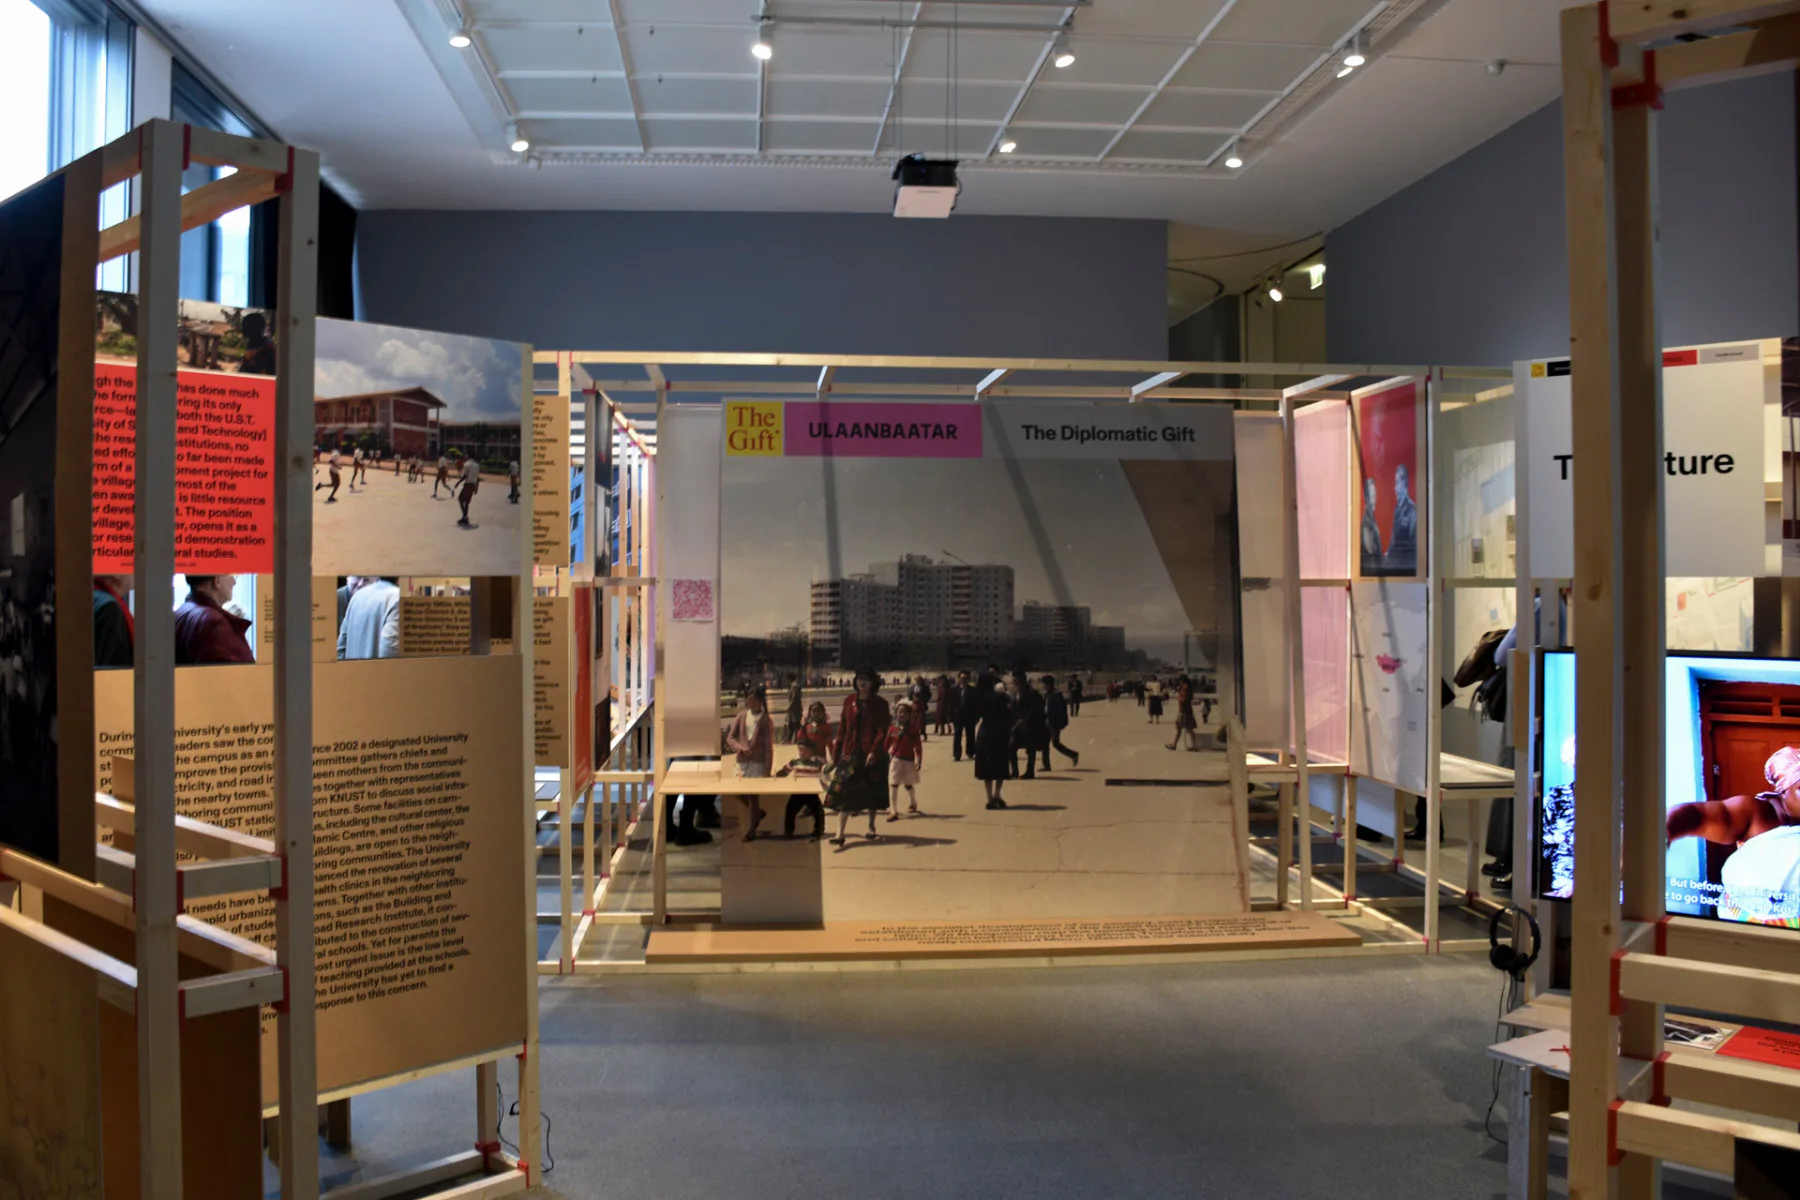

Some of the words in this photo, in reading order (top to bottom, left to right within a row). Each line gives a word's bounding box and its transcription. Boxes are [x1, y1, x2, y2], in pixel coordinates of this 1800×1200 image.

[114, 377, 133, 387] the
[200, 385, 226, 396] done
[229, 388, 259, 398] much
[203, 399, 216, 408] its
[219, 401, 241, 412] only
[114, 419, 126, 429] of
[205, 413, 222, 422] the
[225, 415, 254, 425] U.S.T.
[733, 406, 776, 427] The
[178, 425, 198, 434] and
[201, 427, 267, 441] Technology)
[808, 422, 958, 440] ULAANBAATAR
[1022, 424, 1056, 441] The
[1060, 424, 1157, 446] Diplomatic
[1161, 427, 1195, 443] Gift
[235, 443, 248, 451] no
[728, 430, 775, 452] Gift
[112, 462, 123, 472] of
[125, 464, 131, 472] a
[187, 453, 201, 462] far
[204, 454, 231, 464] been
[234, 456, 264, 466] made
[212, 467, 250, 479] project
[253, 469, 268, 478] for
[205, 481, 216, 490] of
[219, 481, 236, 490] the
[179, 493, 188, 502] is
[191, 494, 215, 504] little
[218, 496, 265, 505] resource
[186, 506, 205, 516] The
[209, 508, 252, 519] position
[190, 522, 223, 533] opens
[226, 522, 232, 531] it
[235, 523, 248, 531] as
[185, 535, 265, 546] demonstration
[194, 548, 237, 559] studies.
[233, 723, 259, 734] early
[213, 739, 235, 749] saw
[238, 737, 255, 746] the
[334, 741, 358, 750] 2002
[369, 737, 420, 750] designated
[424, 733, 468, 744] University
[194, 752, 237, 766] campus
[240, 751, 253, 760] as
[256, 750, 269, 759] an
[360, 752, 397, 764] gathers
[400, 748, 428, 758] chiefs
[431, 747, 447, 756] and
[220, 765, 237, 775] the
[337, 766, 377, 778] mothers
[380, 763, 401, 772] from
[405, 762, 418, 770] the
[217, 779, 236, 789] and
[240, 776, 263, 786] road
[324, 779, 365, 792] together
[368, 777, 387, 787] with
[390, 772, 460, 785] representatives
[194, 791, 231, 806] nearby
[234, 789, 269, 802] towns.
[330, 792, 365, 803] KNUST
[380, 788, 414, 798] discuss
[417, 782, 443, 794] social
[354, 803, 381, 813] Some
[384, 798, 422, 810] facilities
[425, 797, 435, 805] on
[326, 816, 369, 829] including
[372, 814, 386, 824] the
[389, 810, 422, 822] cultural
[424, 808, 454, 818] center,
[456, 805, 469, 814] the
[342, 829, 378, 840] Centre,
[380, 825, 398, 835] and
[400, 822, 424, 833] other
[426, 818, 464, 829] religious
[356, 843, 371, 851] are
[374, 840, 398, 850] open
[401, 836, 410, 845] to
[412, 834, 427, 843] the
[340, 850, 403, 865] communities.
[406, 846, 423, 855] The
[426, 842, 470, 854] University
[351, 868, 366, 877] the
[368, 861, 417, 875] renovation
[420, 858, 428, 866] of
[431, 853, 462, 865] several
[339, 880, 369, 890] clinics
[372, 879, 380, 887] in
[383, 876, 398, 885] the
[400, 868, 455, 883] neighboring
[1671, 878, 1687, 888] But
[1690, 880, 1724, 892] before
[341, 892, 385, 905] Together
[387, 888, 407, 897] with
[410, 884, 433, 893] other
[1672, 892, 1682, 900] to
[1684, 893, 1697, 903] go
[192, 901, 226, 913] needs
[229, 898, 255, 908] have
[336, 907, 359, 917] such
[362, 905, 373, 913] as
[376, 902, 391, 910] the
[394, 896, 431, 908] Building
[434, 891, 451, 900] and
[335, 917, 381, 930] Research
[384, 910, 426, 921] Institute,
[350, 932, 358, 940] to
[362, 929, 376, 938] the
[379, 919, 437, 934] construction
[440, 915, 449, 924] of
[232, 924, 242, 934] of
[328, 944, 368, 957] schools.
[371, 939, 386, 948] Yet
[388, 937, 401, 945] for
[404, 931, 439, 944] parents
[442, 927, 456, 935] the
[335, 956, 367, 969] urgent
[370, 950, 395, 961] issue
[408, 946, 422, 954] the
[425, 943, 440, 951] low
[443, 937, 464, 947] level
[320, 968, 362, 983] teaching
[364, 961, 405, 976] provided
[330, 977, 379, 993] University
[382, 974, 398, 983] has
[400, 971, 414, 981] yet
[417, 968, 426, 976] to
[428, 964, 446, 974] find
[357, 993, 366, 1001] to
[368, 989, 385, 998] this
[388, 982, 427, 995] concern.
